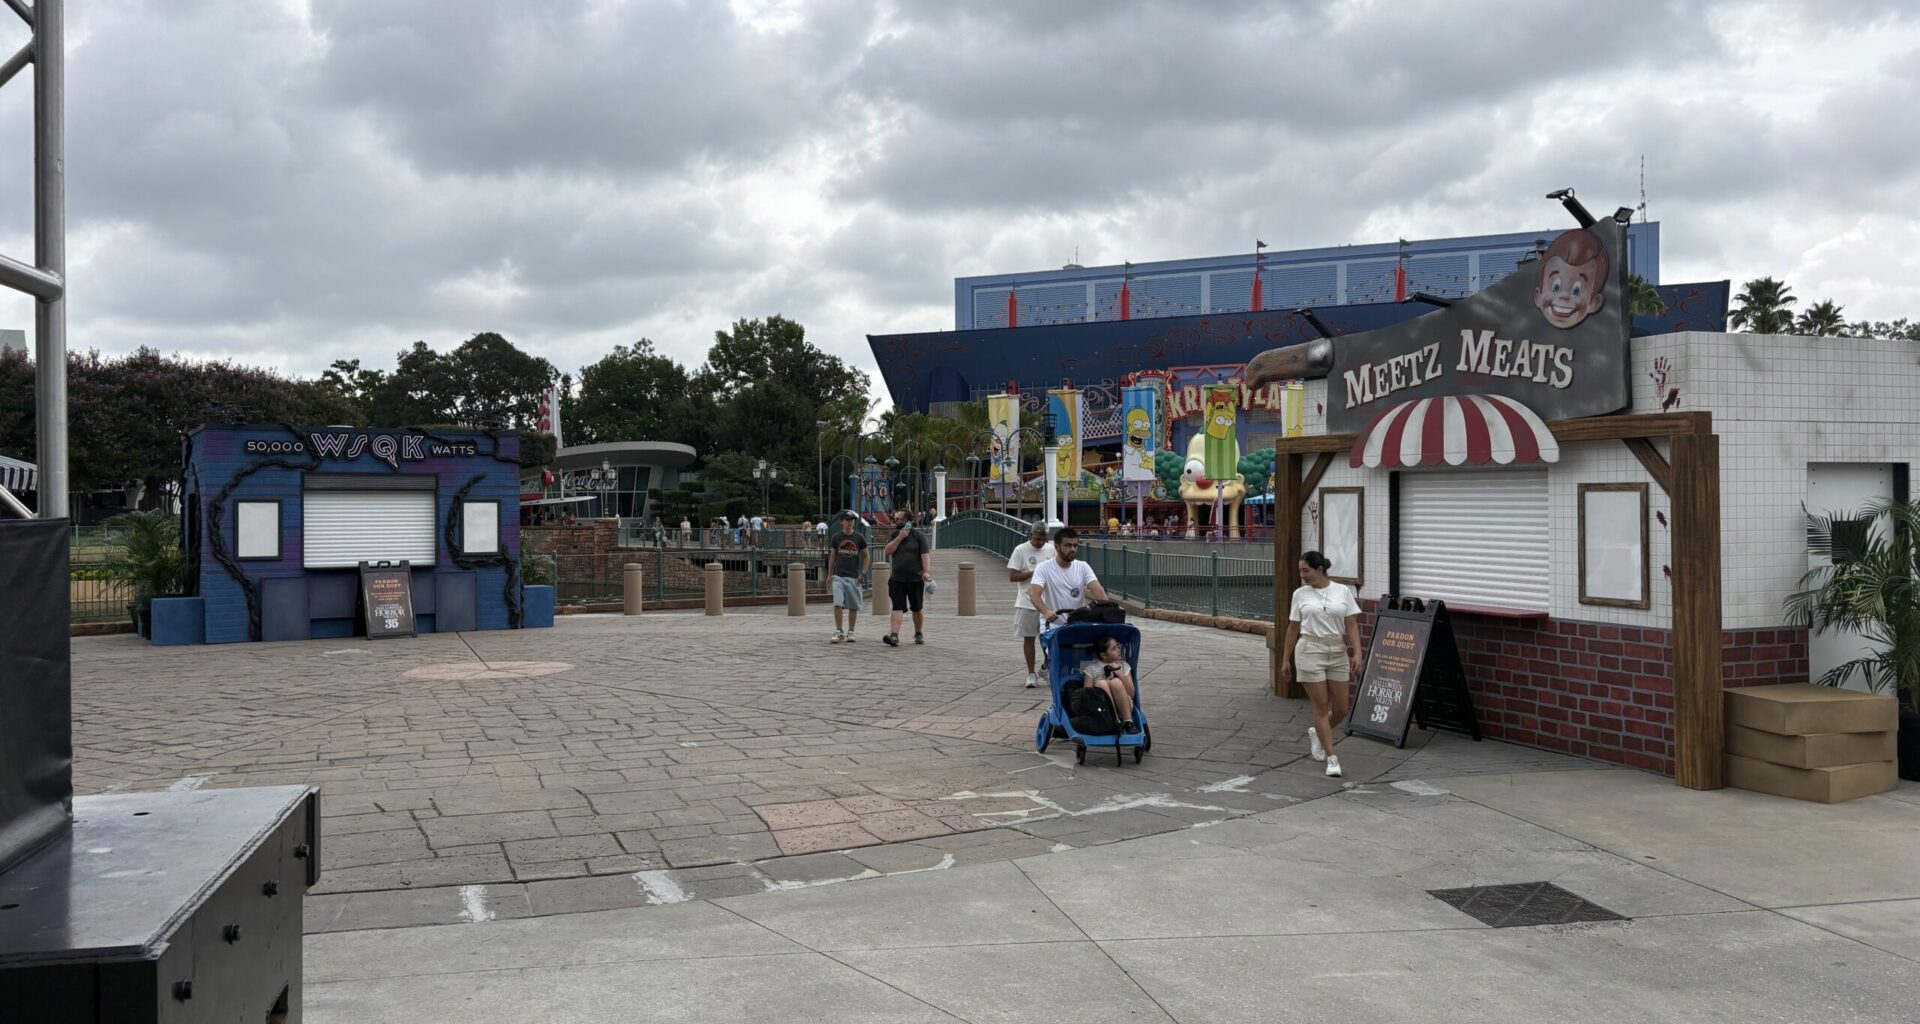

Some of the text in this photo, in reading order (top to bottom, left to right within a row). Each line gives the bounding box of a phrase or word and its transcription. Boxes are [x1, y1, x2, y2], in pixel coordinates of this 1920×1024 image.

[1343, 328, 1574, 410] MEETZ MEATS
[247, 432, 476, 469] 50,000 WSQK WATTS
[384, 618, 399, 629] 35
[1386, 631, 1415, 641] PARDON
[1382, 639, 1416, 650] OUR DUST
[1372, 679, 1402, 691] HALLOWEEN
[1367, 685, 1402, 704] HORROR
[1370, 704, 1390, 723] 35
